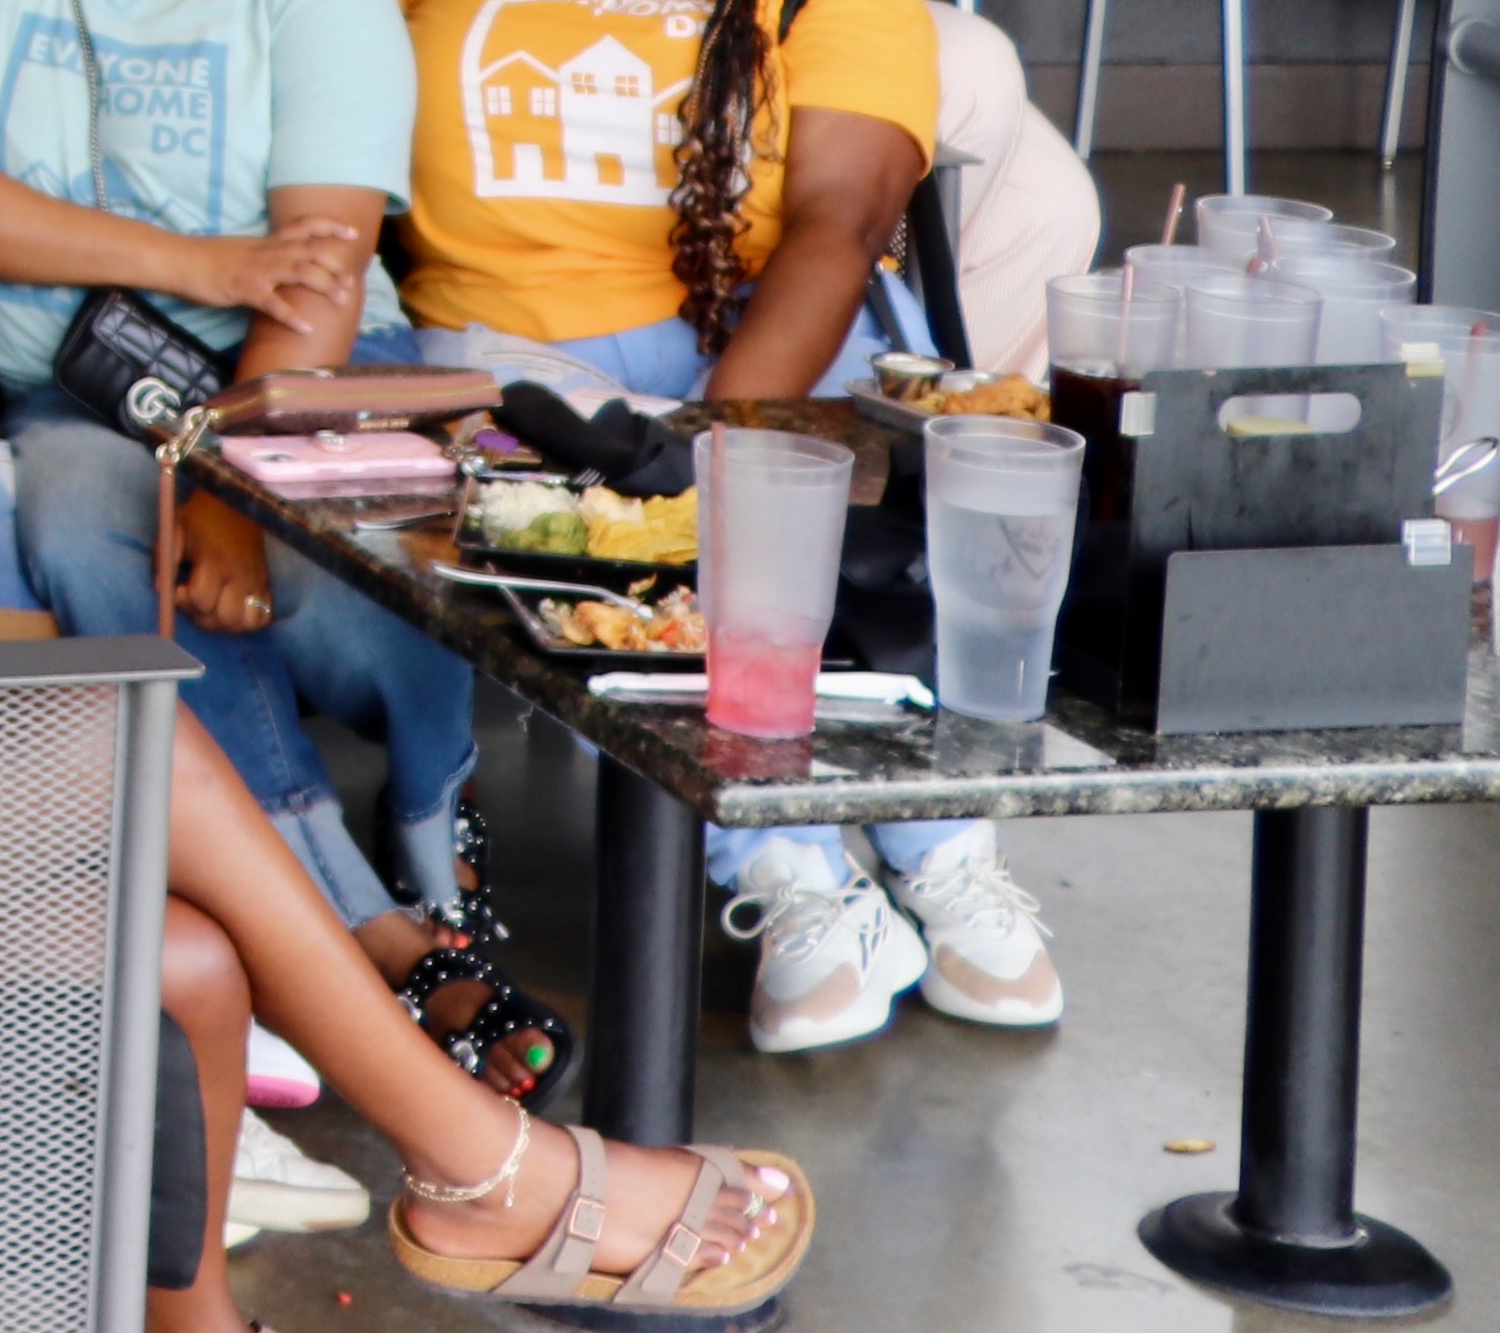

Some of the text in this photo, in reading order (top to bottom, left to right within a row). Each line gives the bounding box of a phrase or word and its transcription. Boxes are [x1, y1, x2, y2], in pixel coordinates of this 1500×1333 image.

[665, 14, 707, 38] D
[28, 31, 211, 87] EVYONE
[152, 123, 207, 158] DC
